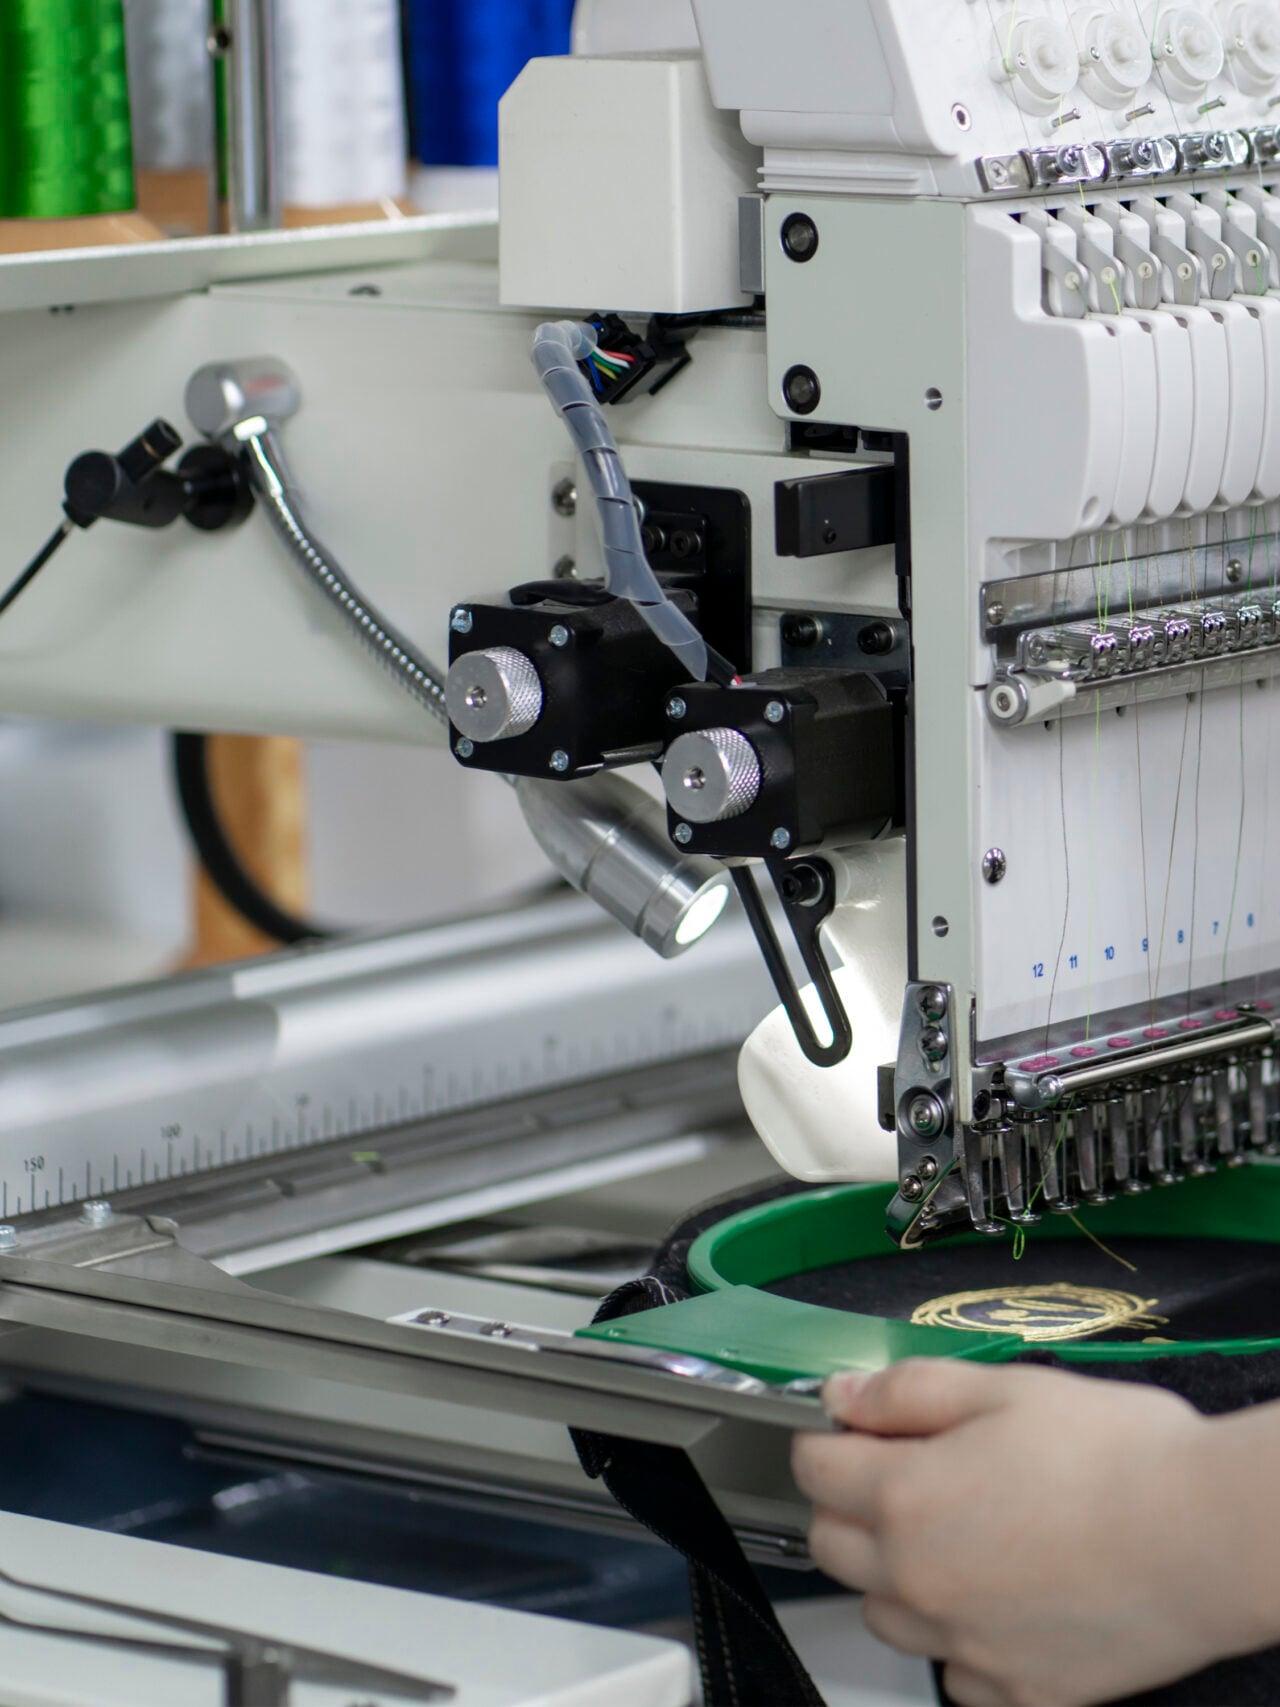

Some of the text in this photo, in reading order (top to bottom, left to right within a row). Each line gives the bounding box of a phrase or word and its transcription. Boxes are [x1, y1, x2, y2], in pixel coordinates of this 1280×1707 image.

[1032, 963, 1044, 978] 12
[1069, 955, 1078, 969] 11
[1104, 946, 1115, 960] 10
[1142, 938, 1149, 951] 9
[1177, 930, 1184, 944] 8
[1212, 921, 1219, 935] 7
[1247, 912, 1254, 927] 6
[160, 1124, 182, 1140] 100
[24, 1155, 45, 1173] 150
